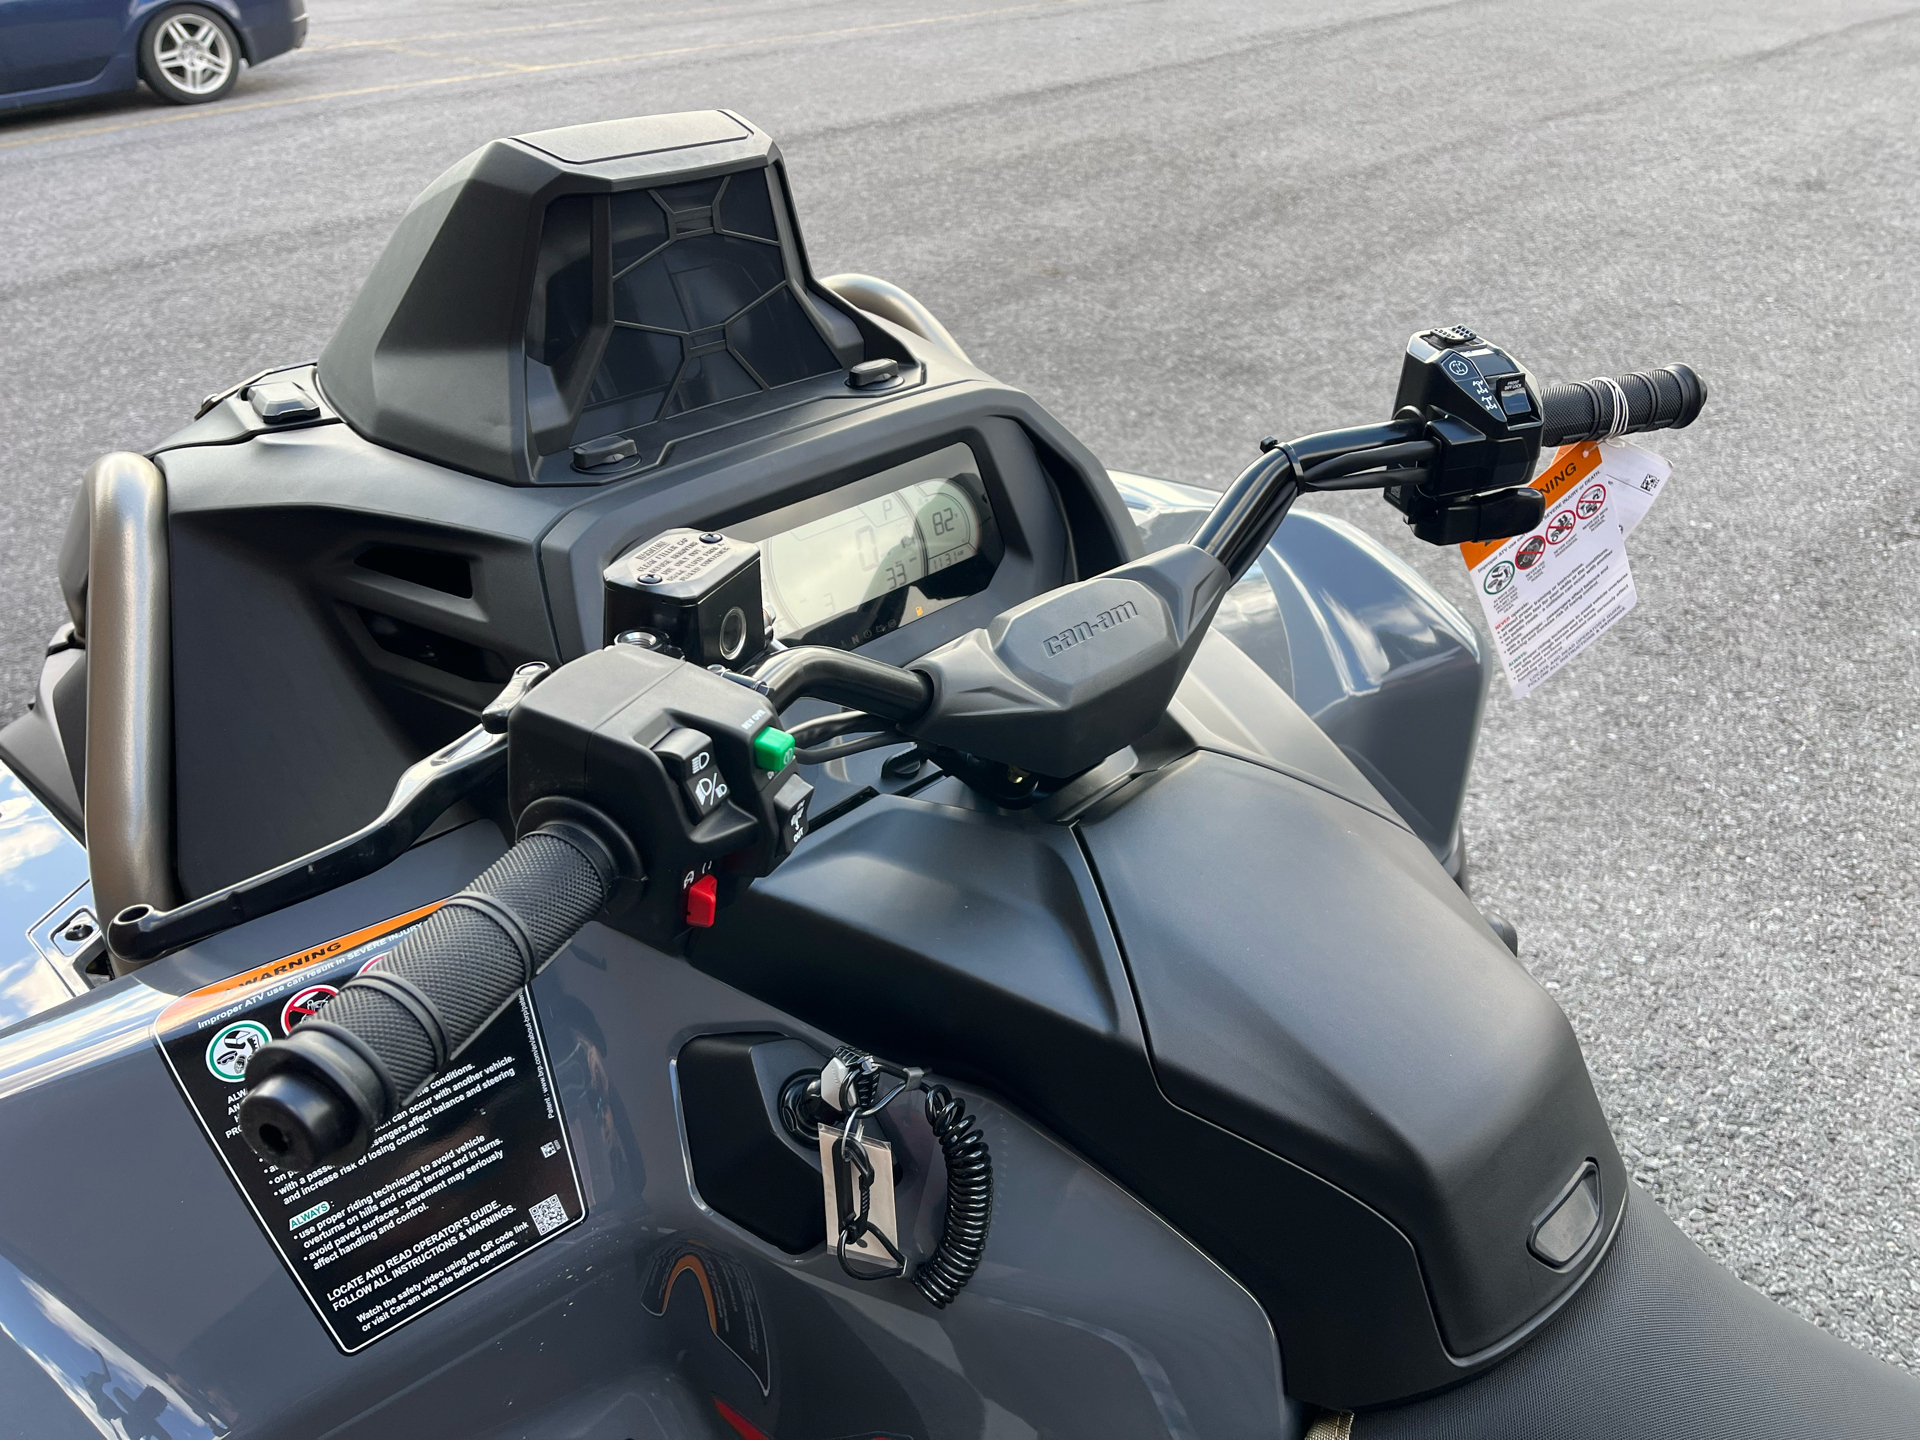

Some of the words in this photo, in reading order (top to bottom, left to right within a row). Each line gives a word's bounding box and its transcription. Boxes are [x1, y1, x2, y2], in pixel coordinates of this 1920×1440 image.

[1540, 462, 1577, 495] NING
[882, 499, 892, 520] P
[1543, 503, 1562, 520] SEVERE
[1562, 487, 1579, 504] INJURY
[932, 507, 955, 536] 82
[1498, 547, 1508, 556] ATV
[1508, 541, 1517, 549] use
[885, 562, 907, 590] 33
[1042, 600, 1139, 659] can-am
[741, 716, 756, 730] REV
[753, 709, 766, 721] OVR
[793, 827, 804, 843] OUT
[197, 1003, 242, 1029] Improper
[244, 992, 264, 1008] ATV
[266, 985, 285, 997] use
[287, 976, 305, 987] can
[306, 963, 335, 979] result
[336, 958, 346, 967] in
[347, 938, 387, 960] SEVERE
[388, 922, 422, 942] INJURY
[392, 1110, 408, 1123] can
[408, 1097, 432, 1114] occur
[433, 1087, 452, 1101] with
[452, 1070, 483, 1091] another
[483, 1056, 515, 1074] vehicle.
[427, 1063, 475, 1089] conditions.
[227, 1088, 248, 1105] ALW
[408, 1110, 433, 1128] affect
[432, 1094, 465, 1115] balance
[465, 1083, 482, 1098] and
[482, 1068, 516, 1089] steering
[547, 1098, 555, 1119] Patent
[274, 1173, 286, 1184] on
[283, 1190, 301, 1205] and
[300, 1172, 339, 1196] increase
[339, 1162, 358, 1175] risk
[358, 1155, 367, 1166] of
[367, 1142, 396, 1160] losing
[396, 1124, 429, 1146] control.
[278, 1180, 298, 1195] with
[299, 1177, 306, 1185] a
[298, 1226, 316, 1239] use
[316, 1209, 345, 1231] proper
[346, 1195, 373, 1213] riding
[372, 1170, 421, 1199] techniques
[420, 1164, 431, 1173] to
[431, 1149, 455, 1168] avoid
[455, 1135, 485, 1155] vehicle
[303, 1222, 346, 1248] overturns
[346, 1215, 359, 1226] on
[358, 1204, 379, 1218] hills
[379, 1192, 397, 1208] and
[397, 1180, 423, 1198] rough
[423, 1165, 452, 1184] terrain
[452, 1154, 469, 1168] and
[468, 1150, 478, 1159] in
[478, 1138, 503, 1154] turns.
[289, 1203, 328, 1228] ALWAYS
[308, 1241, 334, 1260] avoid
[334, 1226, 362, 1248] paved
[362, 1207, 400, 1231] surfaces
[405, 1180, 447, 1209] pavement
[447, 1170, 465, 1185] may
[466, 1150, 503, 1174] seriously
[313, 1251, 339, 1270] affect
[338, 1231, 378, 1256] handling
[378, 1219, 395, 1235] and
[396, 1202, 429, 1224] control.
[327, 1275, 365, 1301] LOCATE
[366, 1264, 386, 1281] AND
[385, 1249, 412, 1268] READ
[412, 1216, 470, 1253] OPERATOR'S
[470, 1200, 501, 1221] GUIDE.
[332, 1283, 372, 1311] FOLLOW
[374, 1274, 392, 1289] ALL
[391, 1236, 458, 1278] INSTRUCTIONS
[465, 1205, 517, 1236] WARNINGS.
[356, 1305, 383, 1322] Watch
[382, 1297, 397, 1308] the
[397, 1282, 421, 1300] safety
[422, 1270, 444, 1286] video
[444, 1257, 468, 1273] using
[467, 1249, 481, 1260] the
[480, 1240, 495, 1252] QR
[494, 1230, 514, 1245] code
[513, 1221, 529, 1234] link
[362, 1322, 371, 1332] or
[371, 1311, 390, 1326] visit
[389, 1294, 421, 1315] Can-am
[420, 1284, 438, 1298] web
[438, 1276, 454, 1288] site
[453, 1261, 479, 1279] before
[480, 1240, 518, 1264] operation.
